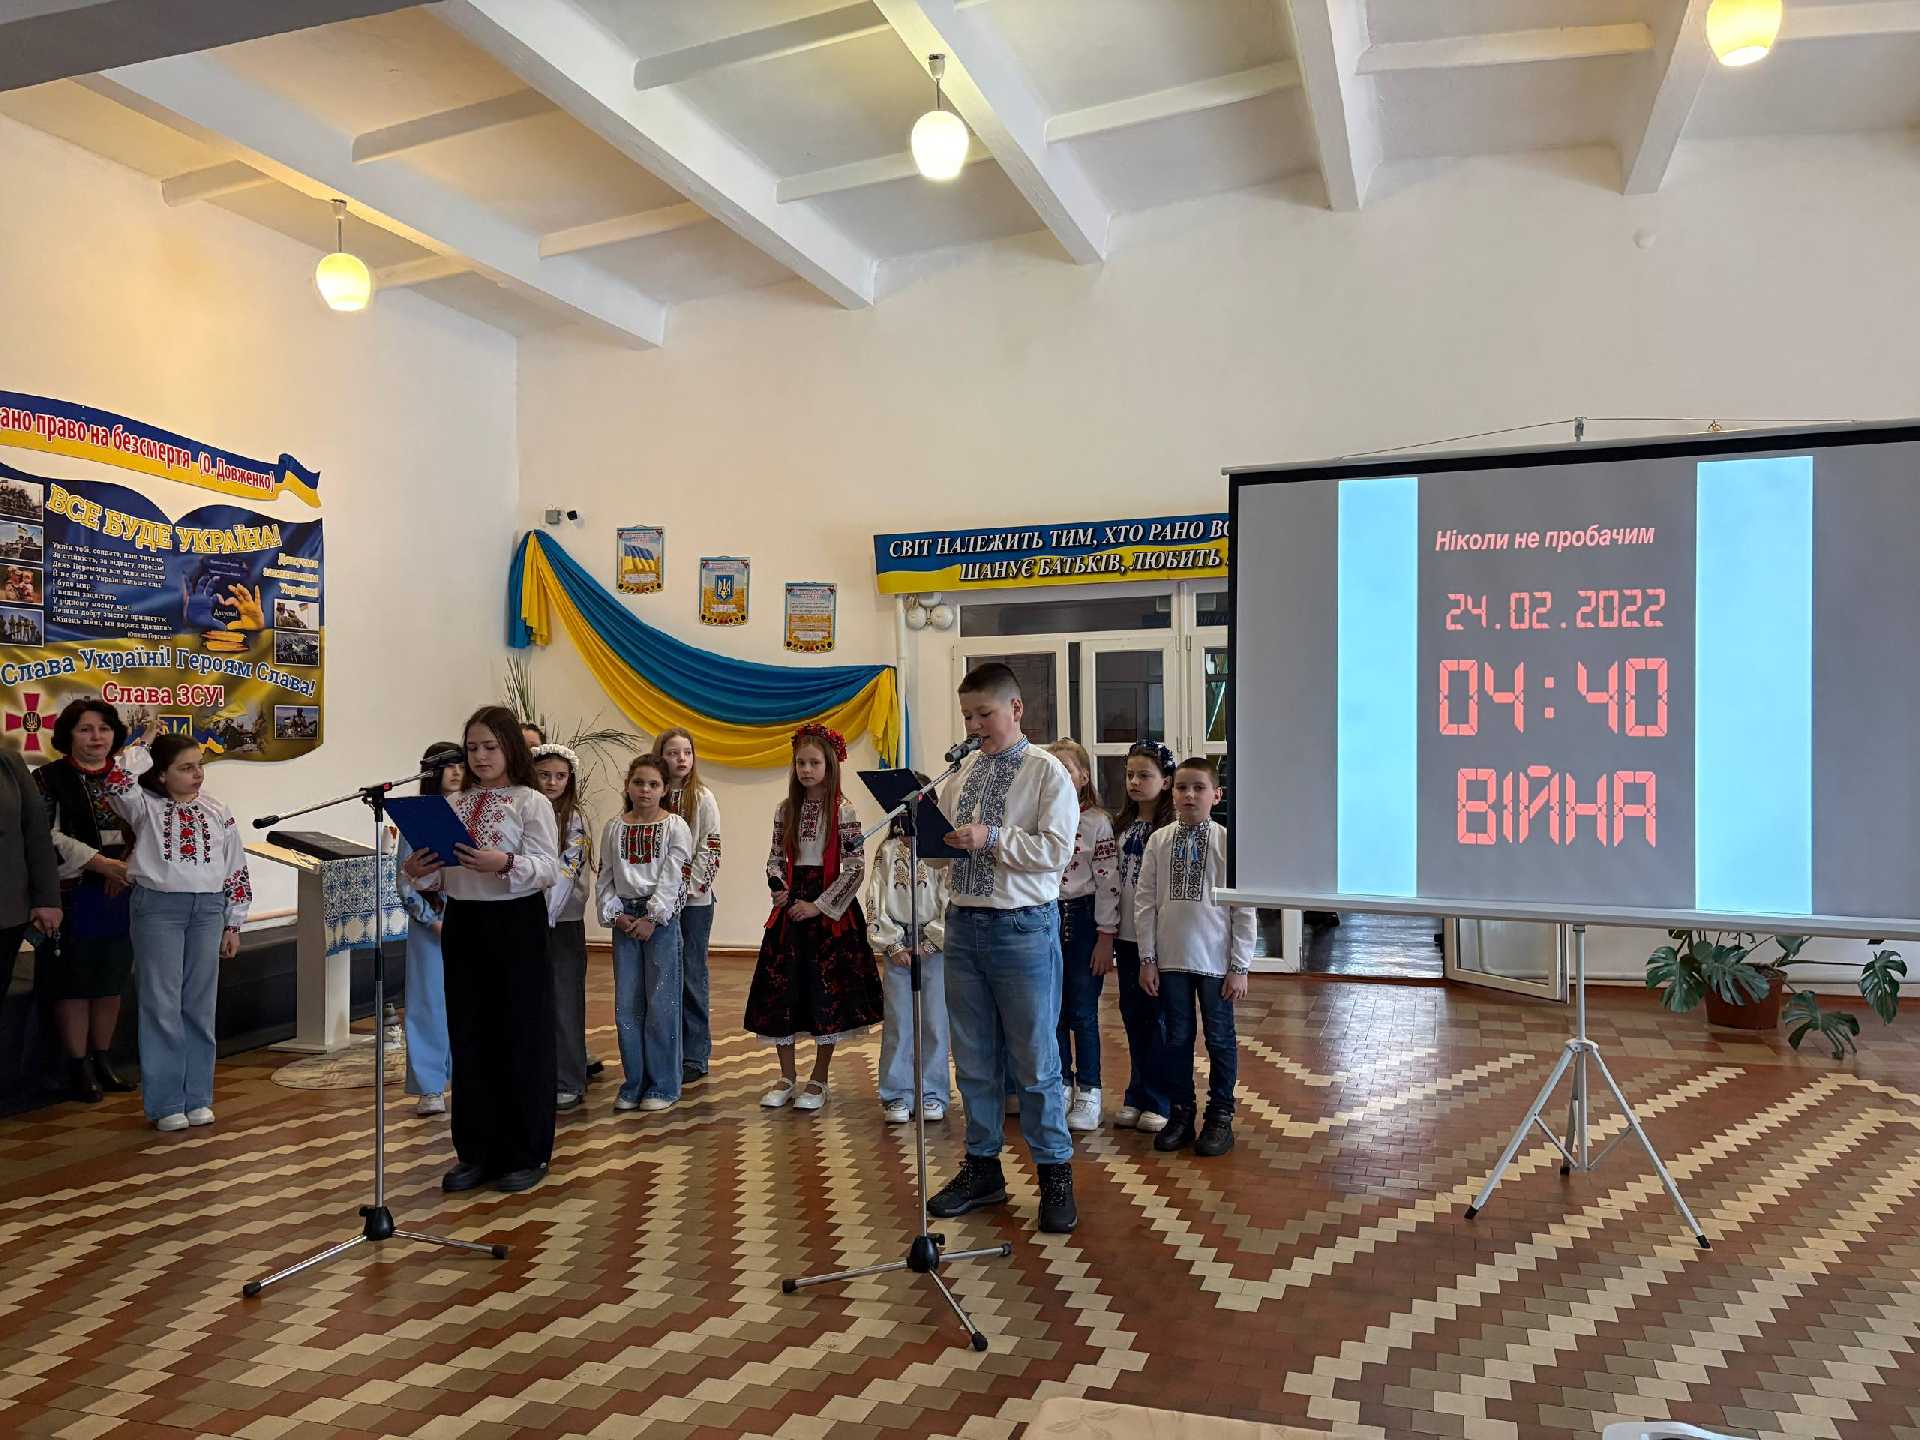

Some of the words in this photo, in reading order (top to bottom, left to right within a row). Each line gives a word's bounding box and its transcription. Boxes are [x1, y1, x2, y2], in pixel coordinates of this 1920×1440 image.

[36, 413, 87, 442] право
[89, 424, 109, 447] на
[113, 424, 192, 472] безсмертя
[216, 458, 275, 493] Довженко)
[46, 483, 102, 529] ВСЕ
[103, 508, 173, 552] БУДЕ
[175, 523, 282, 554] УКРАЇНА!
[889, 538, 933, 558] СВІТ
[935, 532, 1043, 556] НАЛЕЖИТЬ
[1049, 526, 1098, 548] ТИМ,
[1102, 523, 1144, 544] ХТО
[1149, 520, 1204, 540] РАНО
[1436, 529, 1509, 551] Ніколи
[1515, 529, 1540, 549] не
[1545, 523, 1655, 552] пробачим
[959, 558, 1034, 582] ШАНУЄ
[1038, 552, 1125, 577] БАТЬКІВ,
[1130, 548, 1220, 571] ЛЮБИТЬ
[1445, 588, 1666, 630] 24.02.2022
[1, 655, 76, 686] Слава
[78, 647, 170, 674] Україні!
[176, 647, 253, 678] Героям
[255, 666, 317, 697] Слава!
[102, 681, 172, 706] Слава
[176, 684, 225, 707] ЗСУ!
[1457, 765, 1656, 848] ВІЙНА
